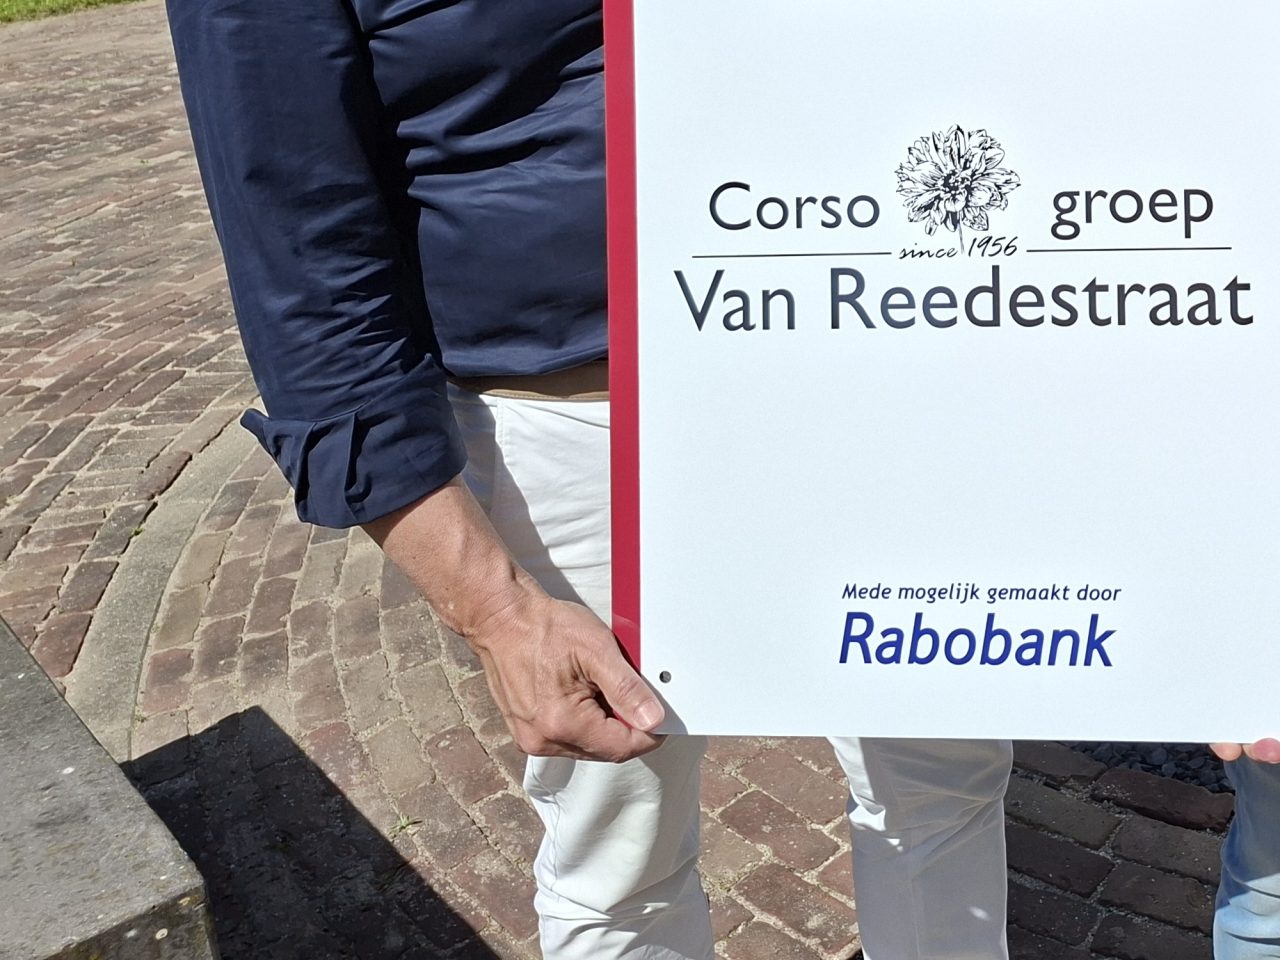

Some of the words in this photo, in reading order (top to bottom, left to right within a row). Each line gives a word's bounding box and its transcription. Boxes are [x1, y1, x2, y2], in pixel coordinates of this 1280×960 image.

[710, 182, 879, 230] Corso
[1051, 189, 1213, 240] groep
[900, 243, 957, 259] since
[968, 236, 1018, 257] 1956
[674, 270, 795, 331] Van
[831, 265, 1253, 329] Reedestraat
[842, 583, 891, 599] Mede
[898, 583, 979, 603] mogelijk
[987, 584, 1069, 604] gemaakt
[1077, 584, 1121, 600] door
[839, 612, 1116, 666] Rabobank
